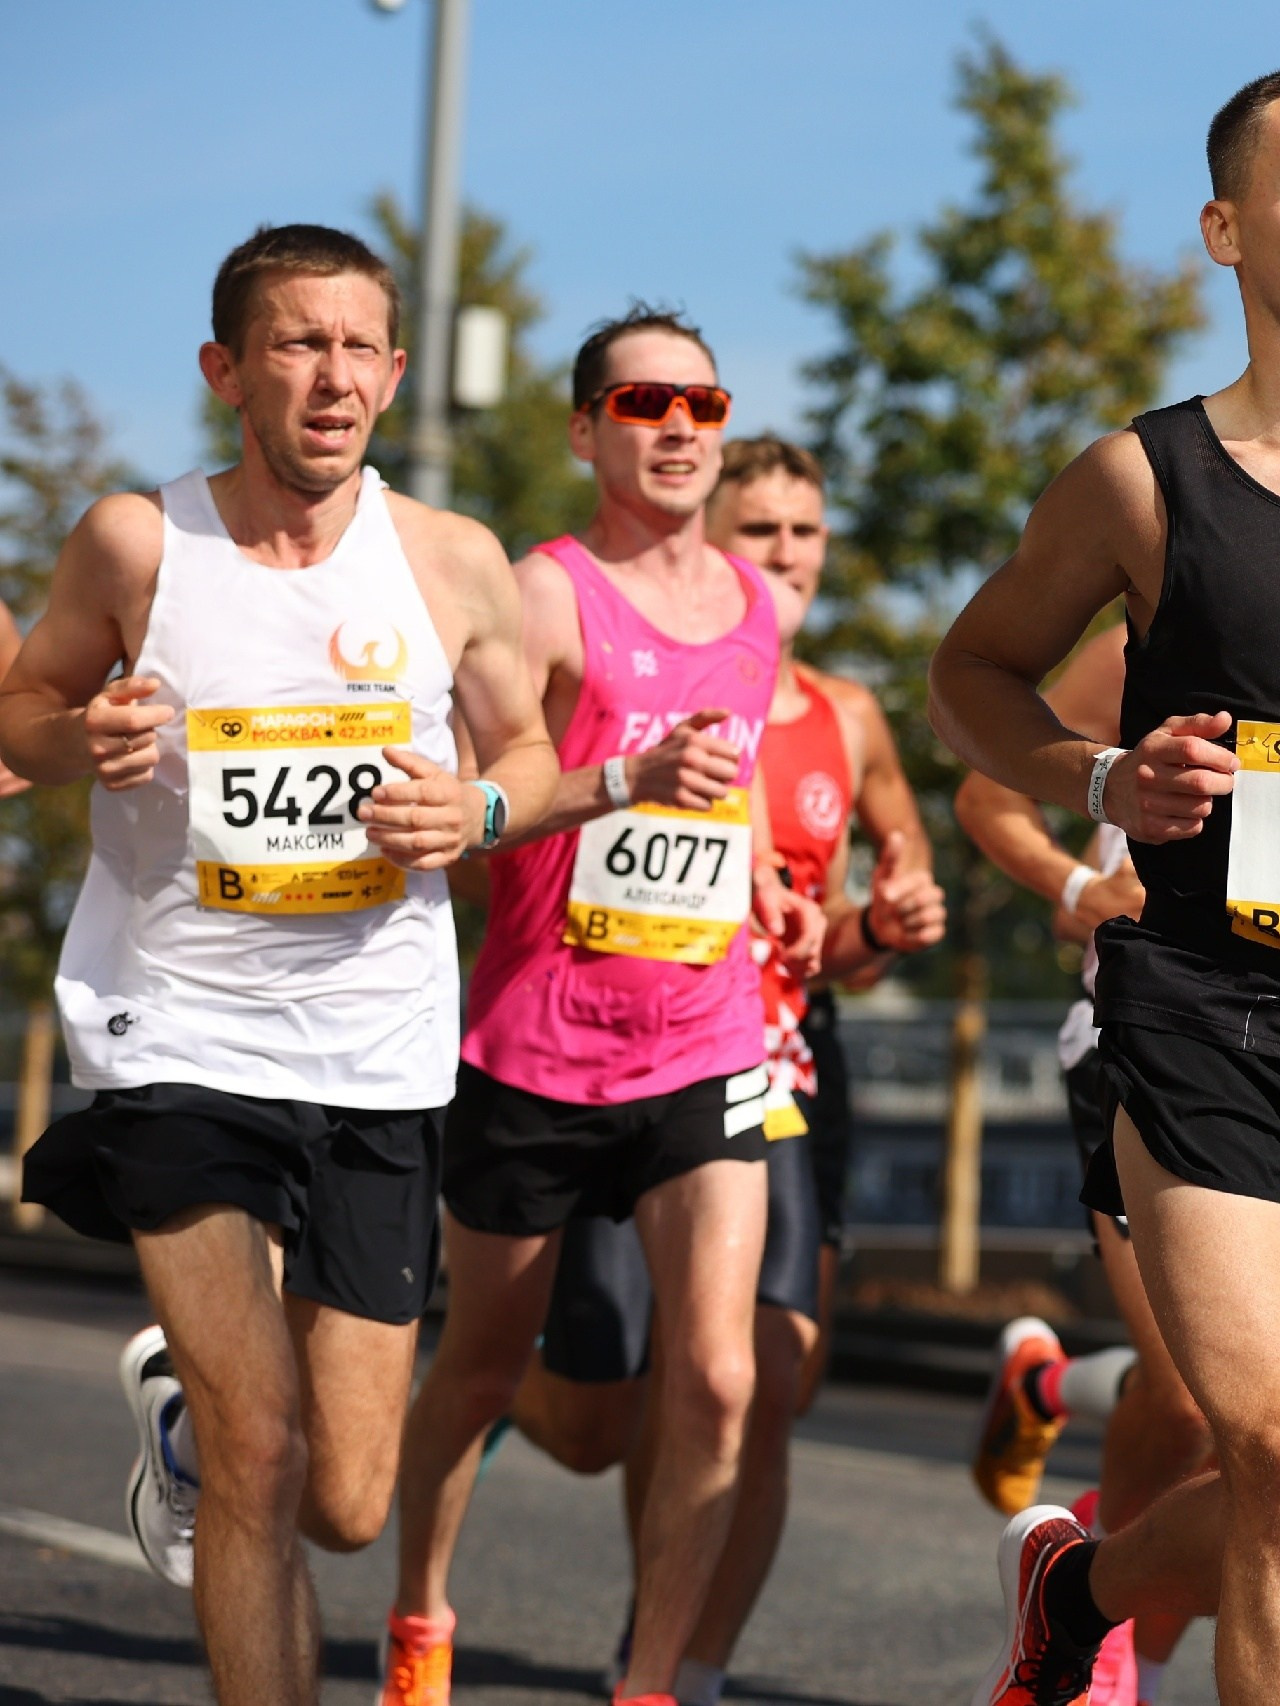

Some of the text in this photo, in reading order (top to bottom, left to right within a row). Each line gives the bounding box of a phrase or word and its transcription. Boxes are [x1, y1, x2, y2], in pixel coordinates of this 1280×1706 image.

[374, 684, 396, 693] TEAM
[251, 713, 335, 728] МАРАФОН
[252, 727, 322, 742] МОСКВА
[371, 726, 393, 738] КМ
[222, 764, 383, 828] 5428
[266, 833, 345, 852] МАКСИМ
[606, 828, 729, 887] 6077
[218, 868, 245, 900] B
[587, 911, 609, 940] B
